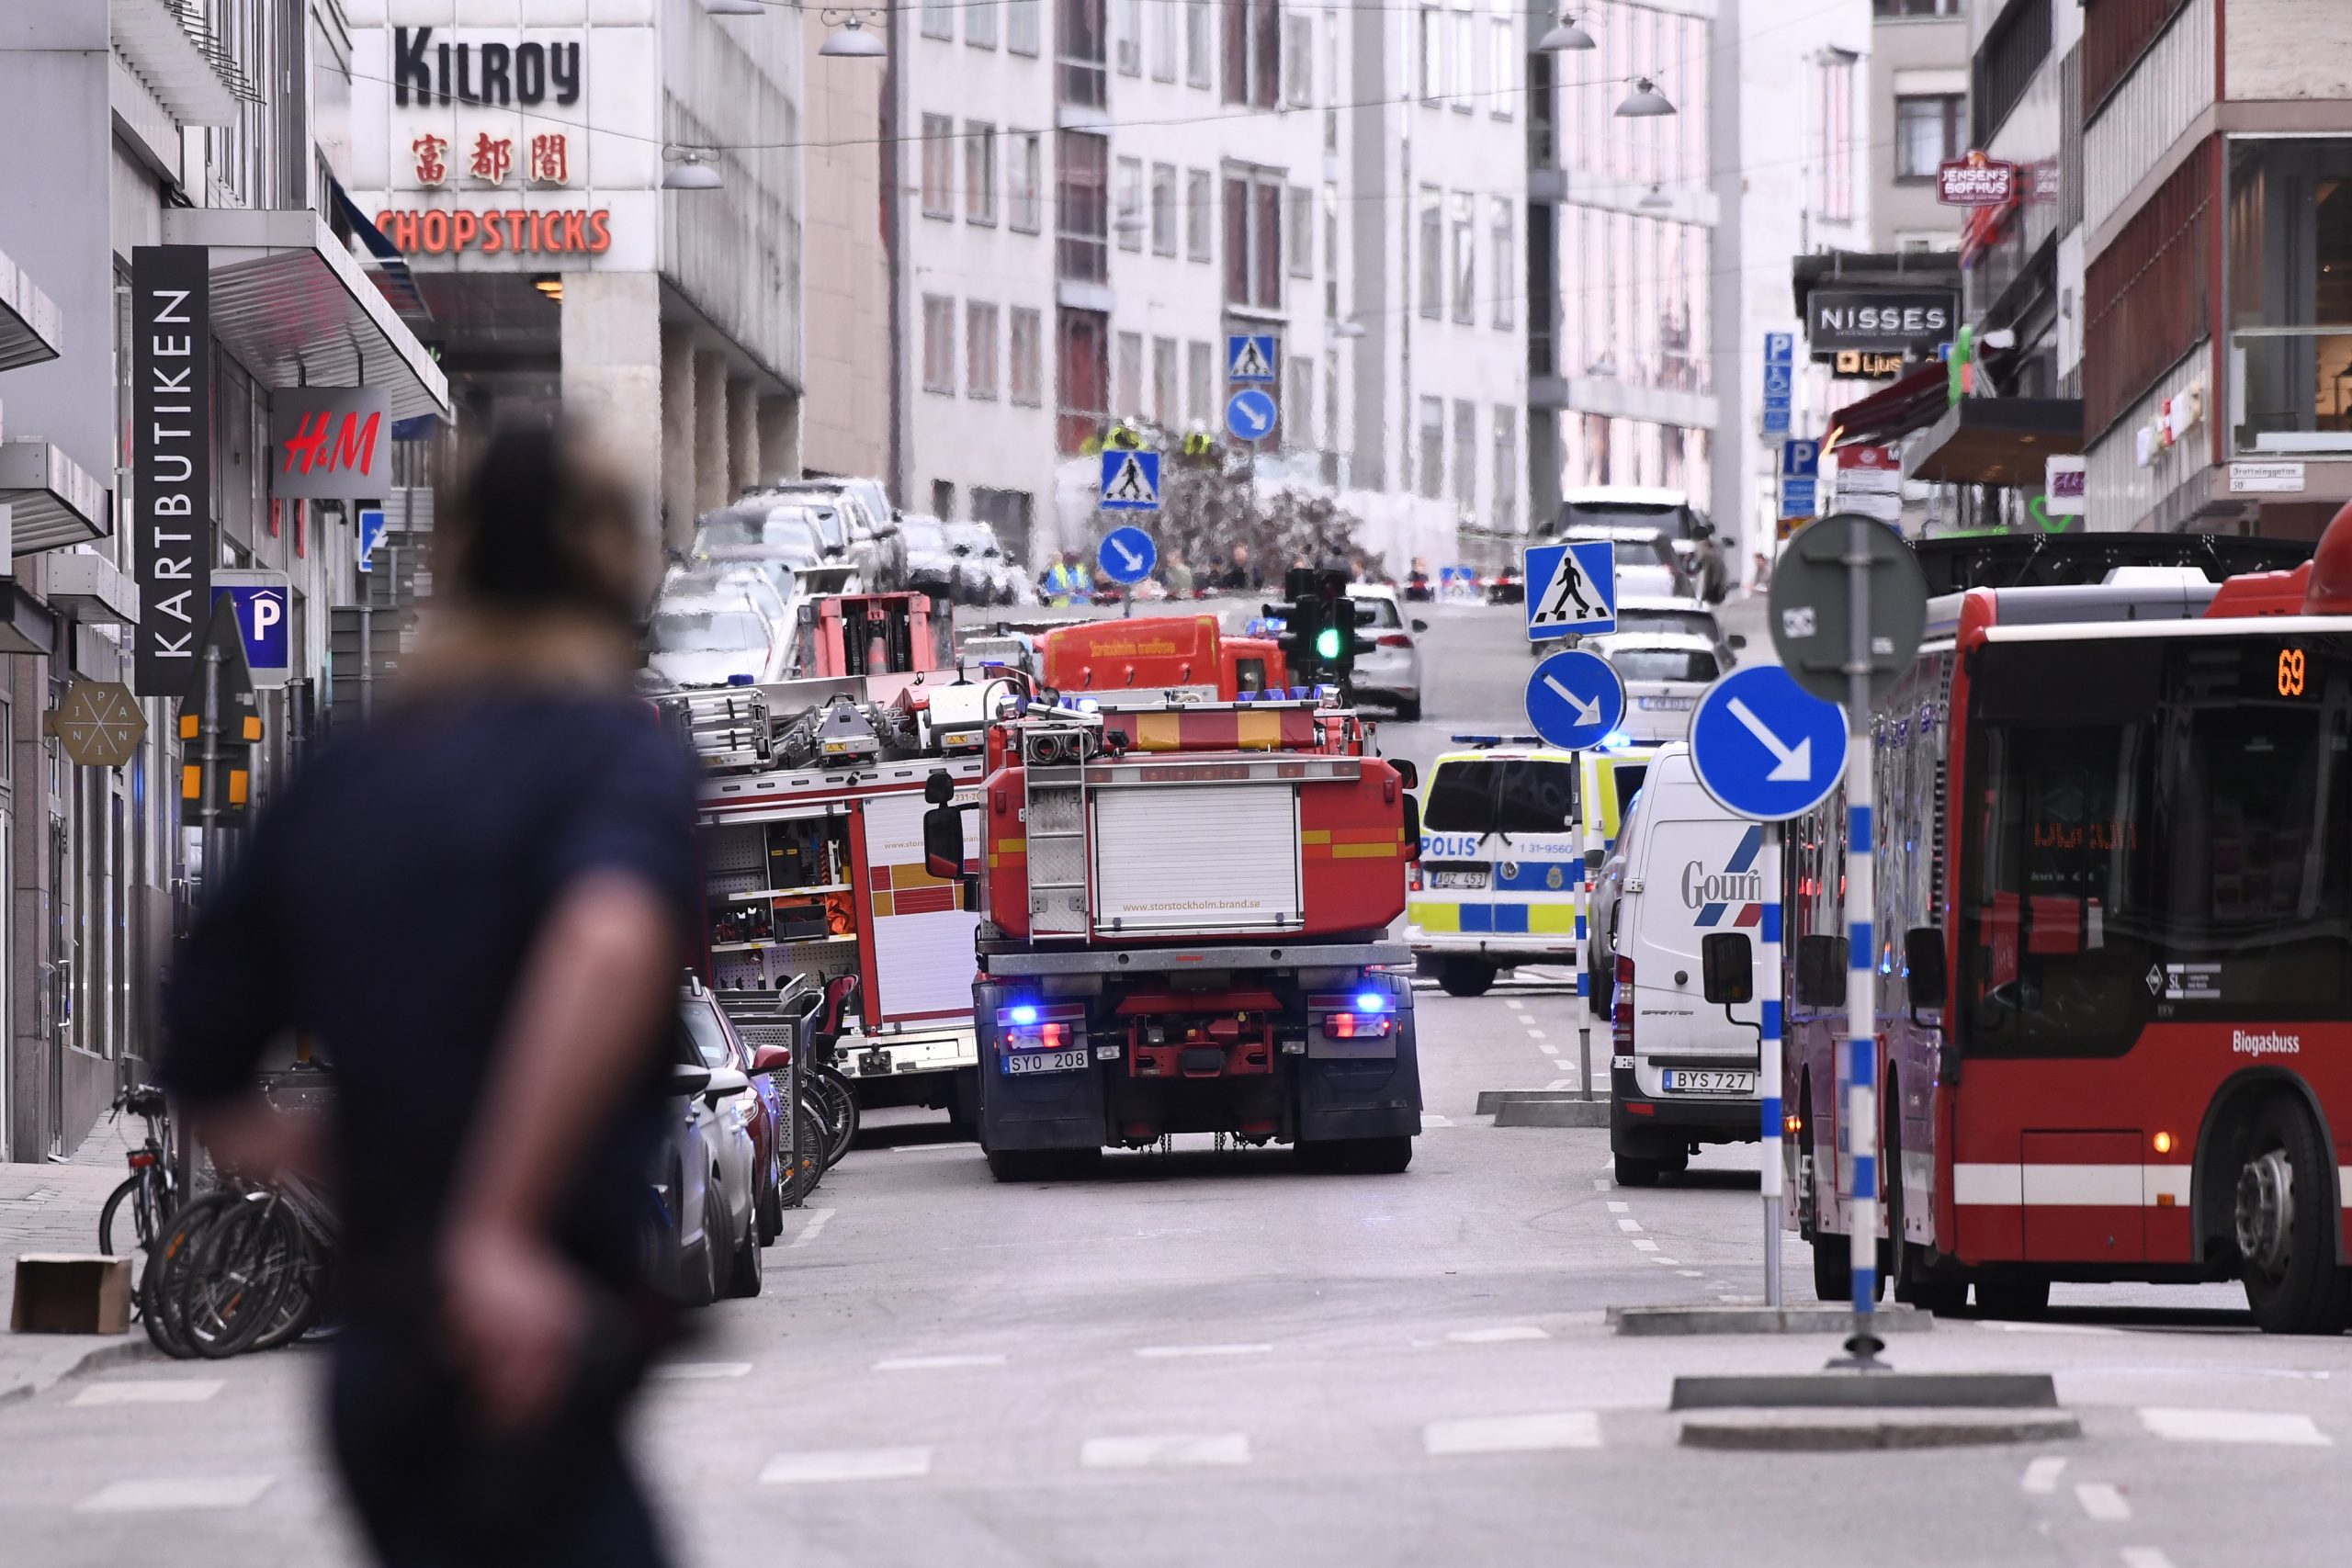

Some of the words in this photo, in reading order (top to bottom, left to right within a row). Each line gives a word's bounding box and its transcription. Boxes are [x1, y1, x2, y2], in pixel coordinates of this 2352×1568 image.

[395, 27, 580, 106] KILROY
[1942, 169, 2009, 182] JENSEN'S
[1821, 306, 1947, 332] NISSES
[283, 411, 381, 476] H&M
[153, 289, 193, 658] KARTBUTIKEN
[254, 599, 281, 640] P
[2278, 649, 2305, 696] 69
[1420, 836, 1476, 857] POLIS
[1464, 874, 1483, 885] 453
[1123, 899, 1261, 912] www.storstockholm.brand.se
[2233, 1030, 2301, 1058] Biogasbuss
[1012, 1056, 1042, 1072] SYO
[1054, 1052, 1085, 1068] 208
[1678, 1072, 1710, 1088] BYS
[1714, 1073, 1747, 1089] 727
